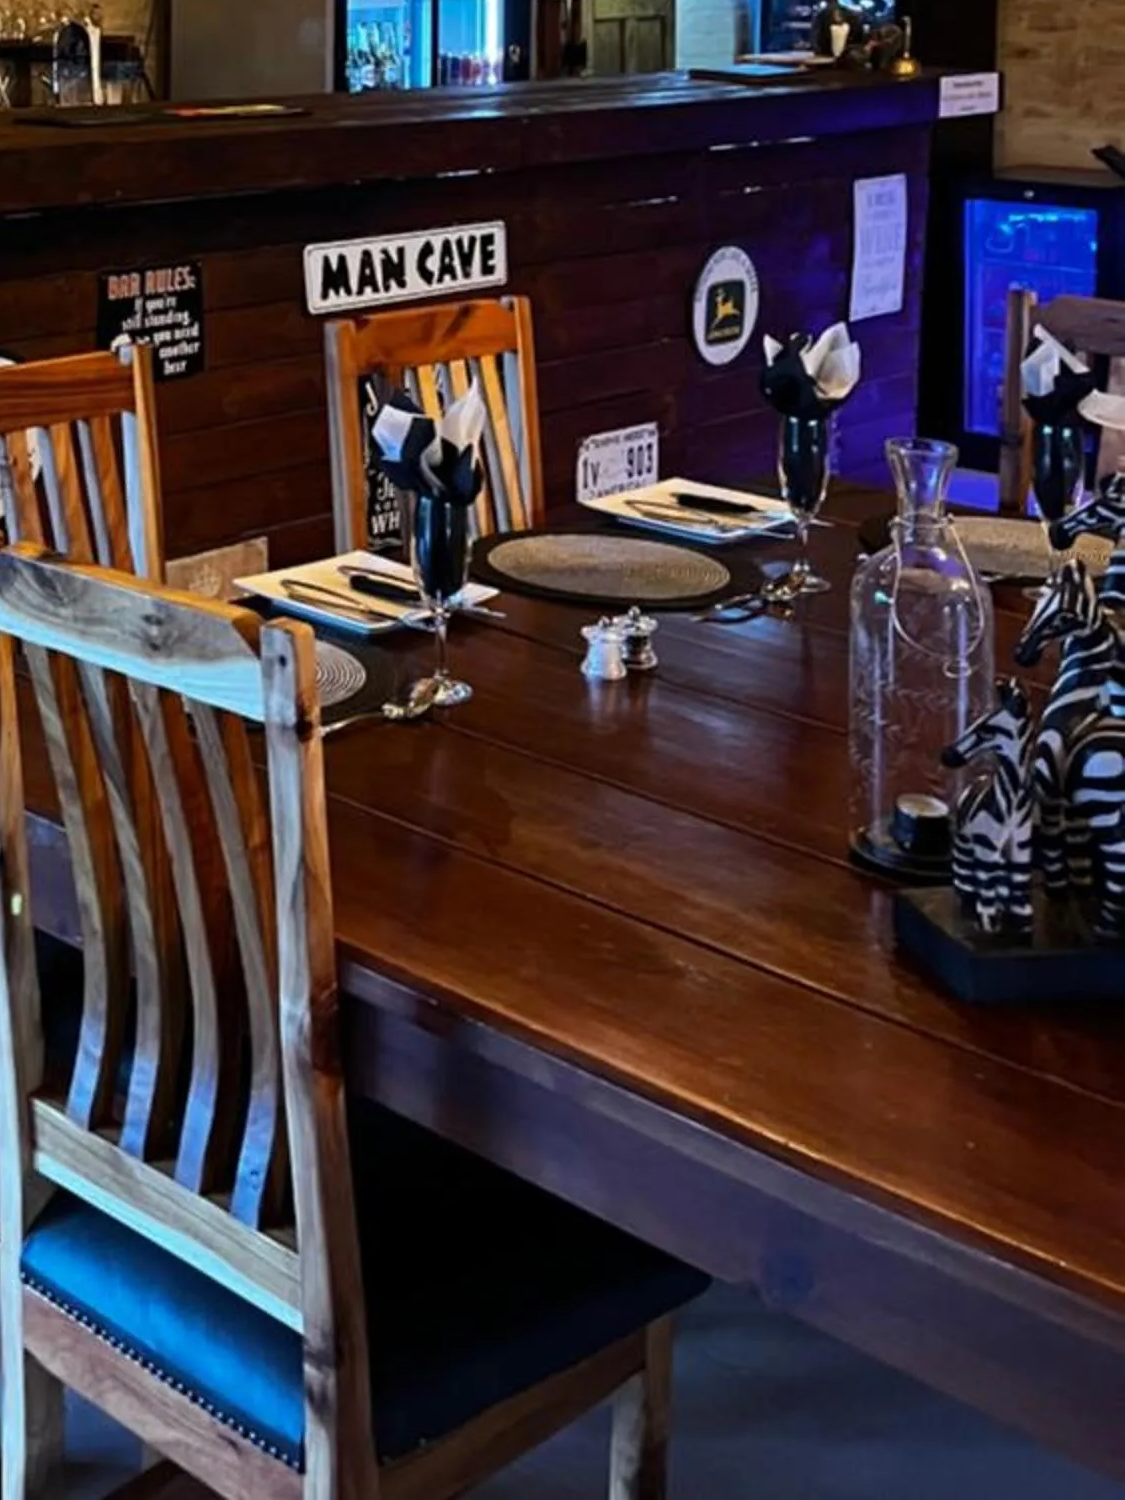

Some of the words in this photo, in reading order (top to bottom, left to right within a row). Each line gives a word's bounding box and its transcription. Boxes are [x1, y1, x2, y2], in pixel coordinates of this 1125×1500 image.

[108, 272, 140, 299] BAR
[321, 246, 407, 300] MAN
[416, 233, 496, 286] CAVE
